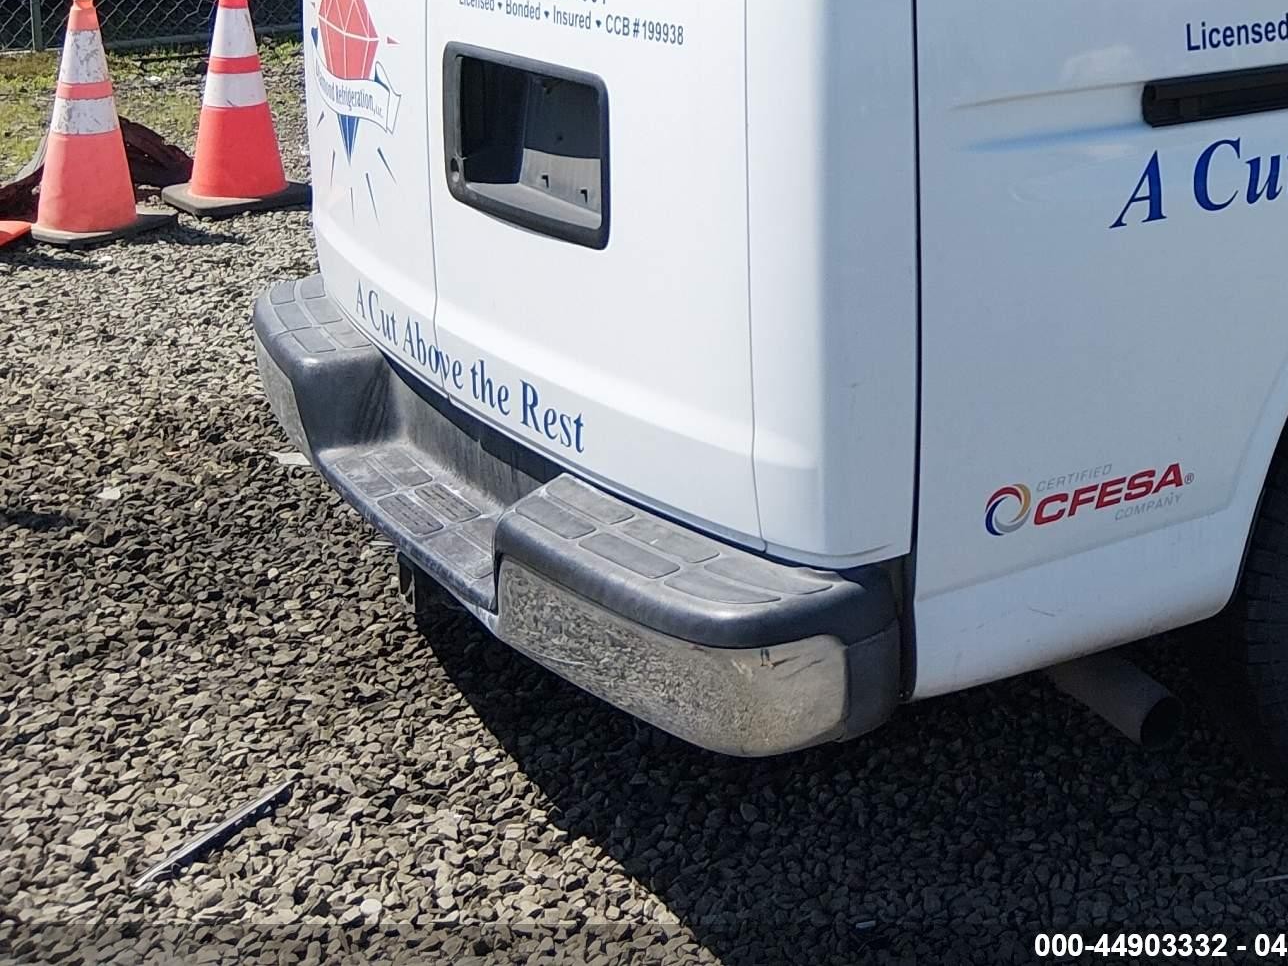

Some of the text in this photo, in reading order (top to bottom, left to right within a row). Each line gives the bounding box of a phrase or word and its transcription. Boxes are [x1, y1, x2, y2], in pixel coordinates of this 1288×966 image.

[553, 5, 591, 29] Insured
[605, 14, 630, 37] CCB
[633, 18, 684, 45] #199938
[1109, 150, 1167, 228] A
[356, 279, 584, 453] A Cut Above the Rest
[1036, 463, 1112, 493] CERTIFIED
[1115, 493, 1183, 521] COMPANY
